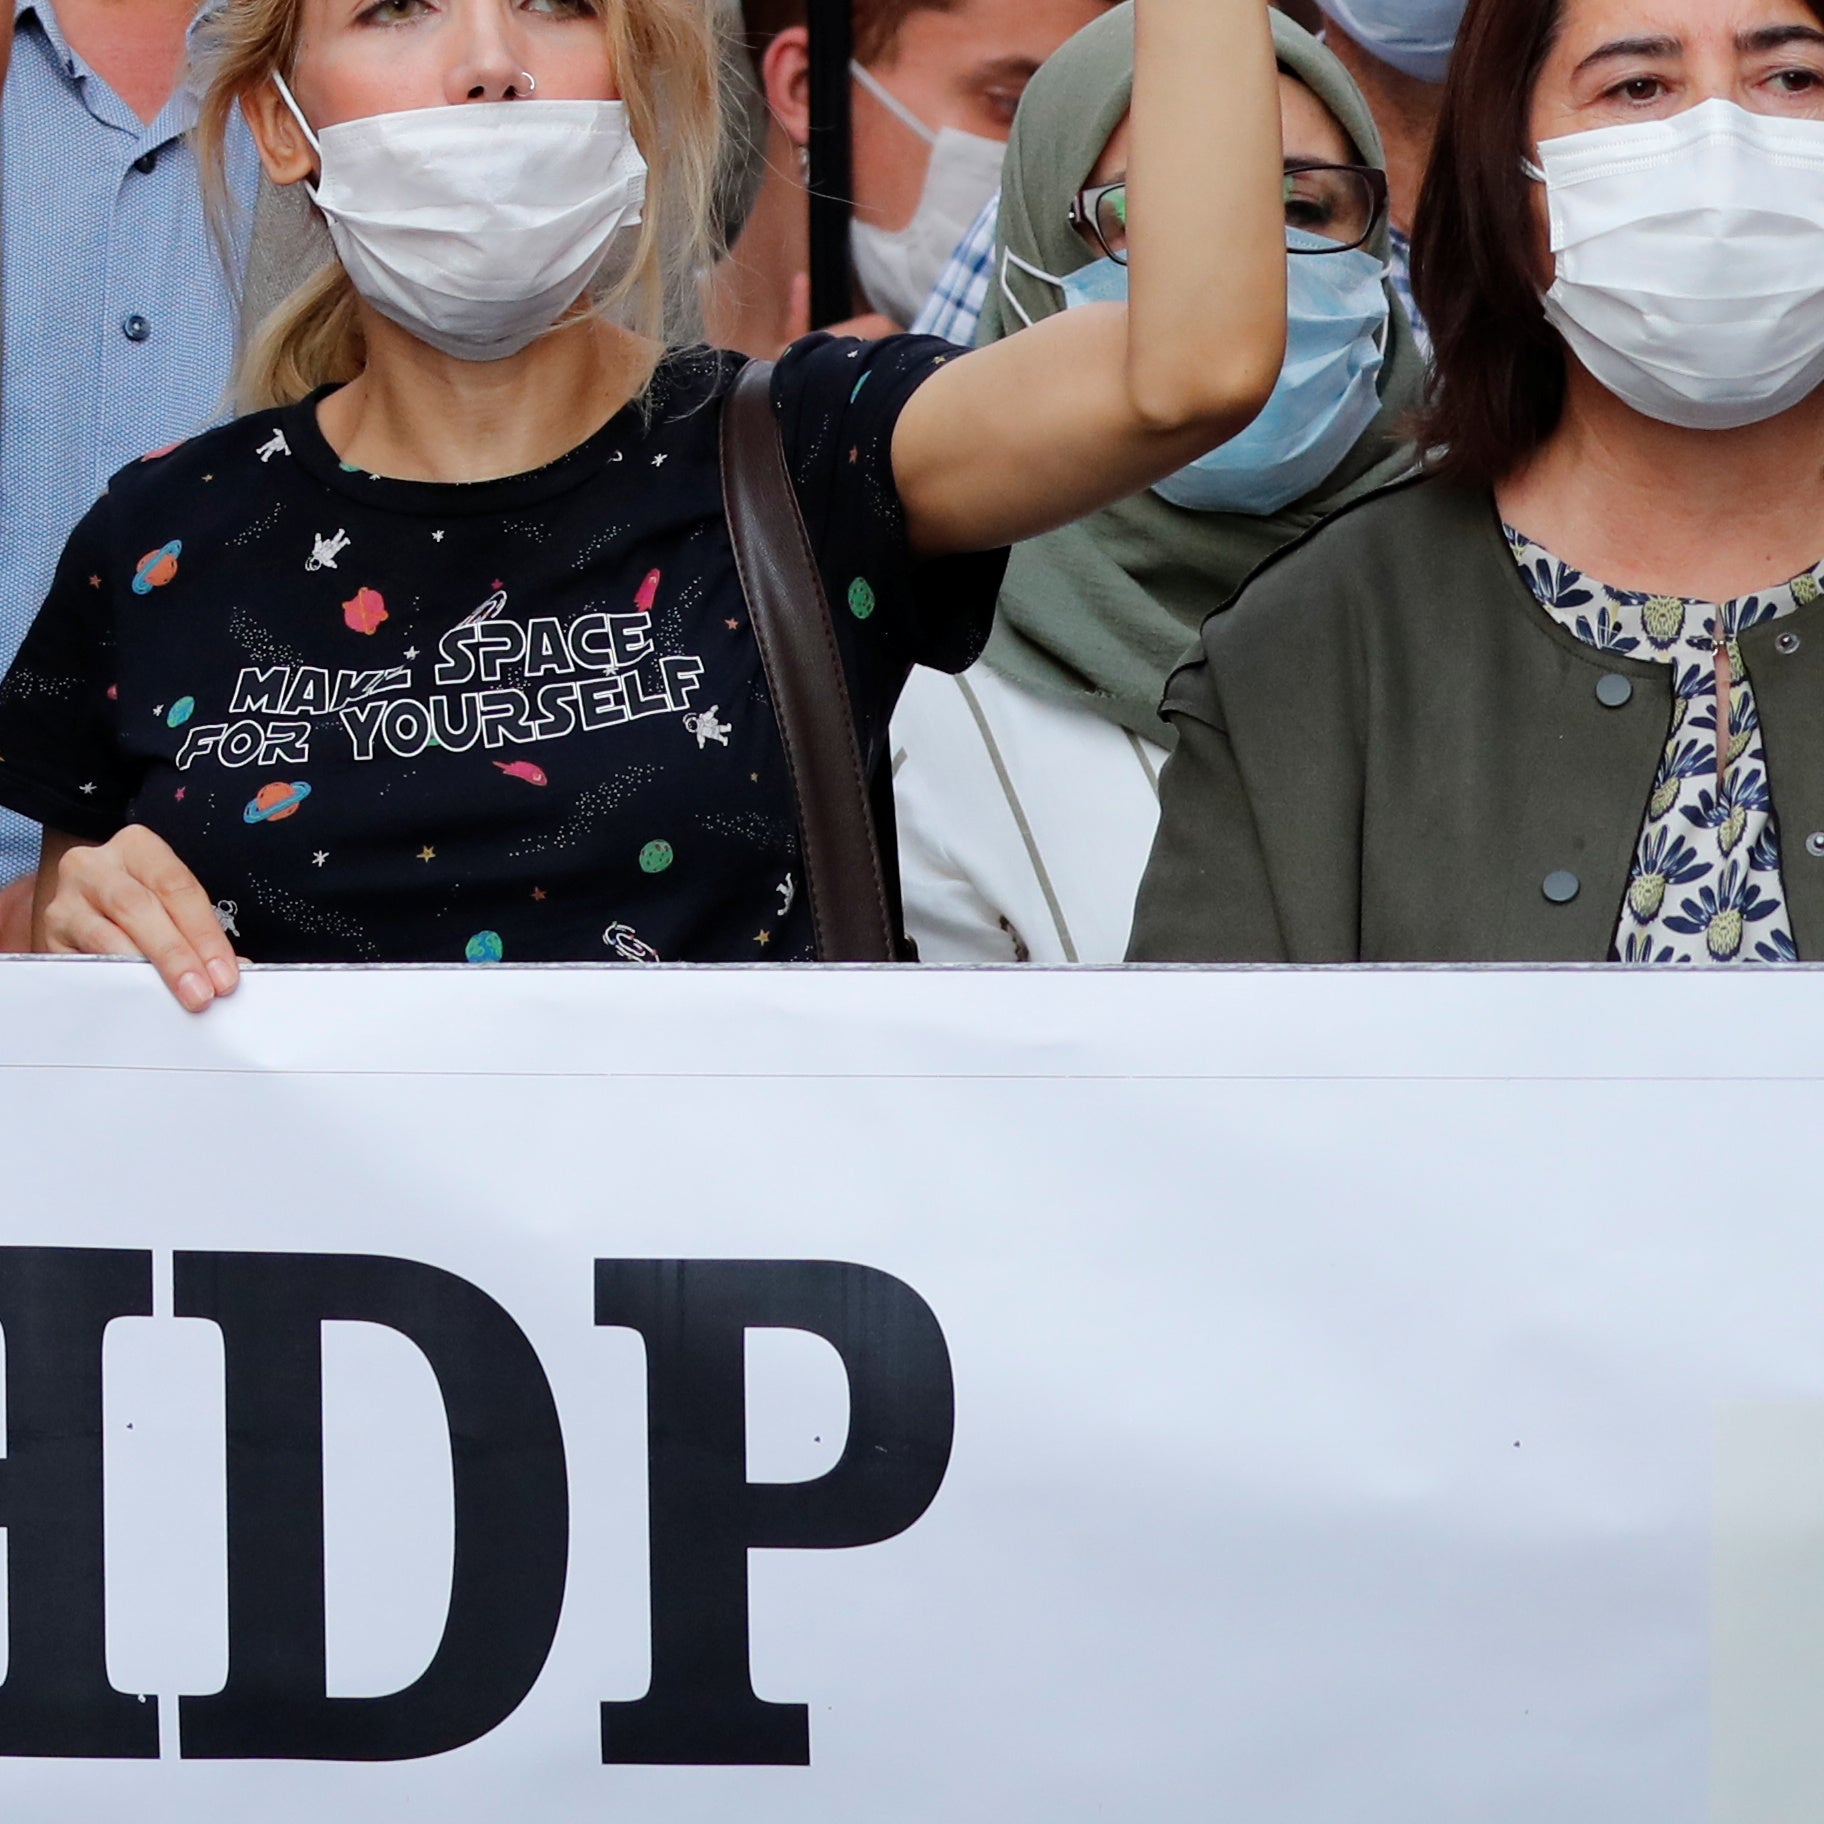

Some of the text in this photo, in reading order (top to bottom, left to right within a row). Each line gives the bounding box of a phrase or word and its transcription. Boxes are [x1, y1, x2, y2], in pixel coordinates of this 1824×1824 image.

[435, 611, 656, 686] SPACE
[175, 655, 706, 771] FOR YOURSELF
